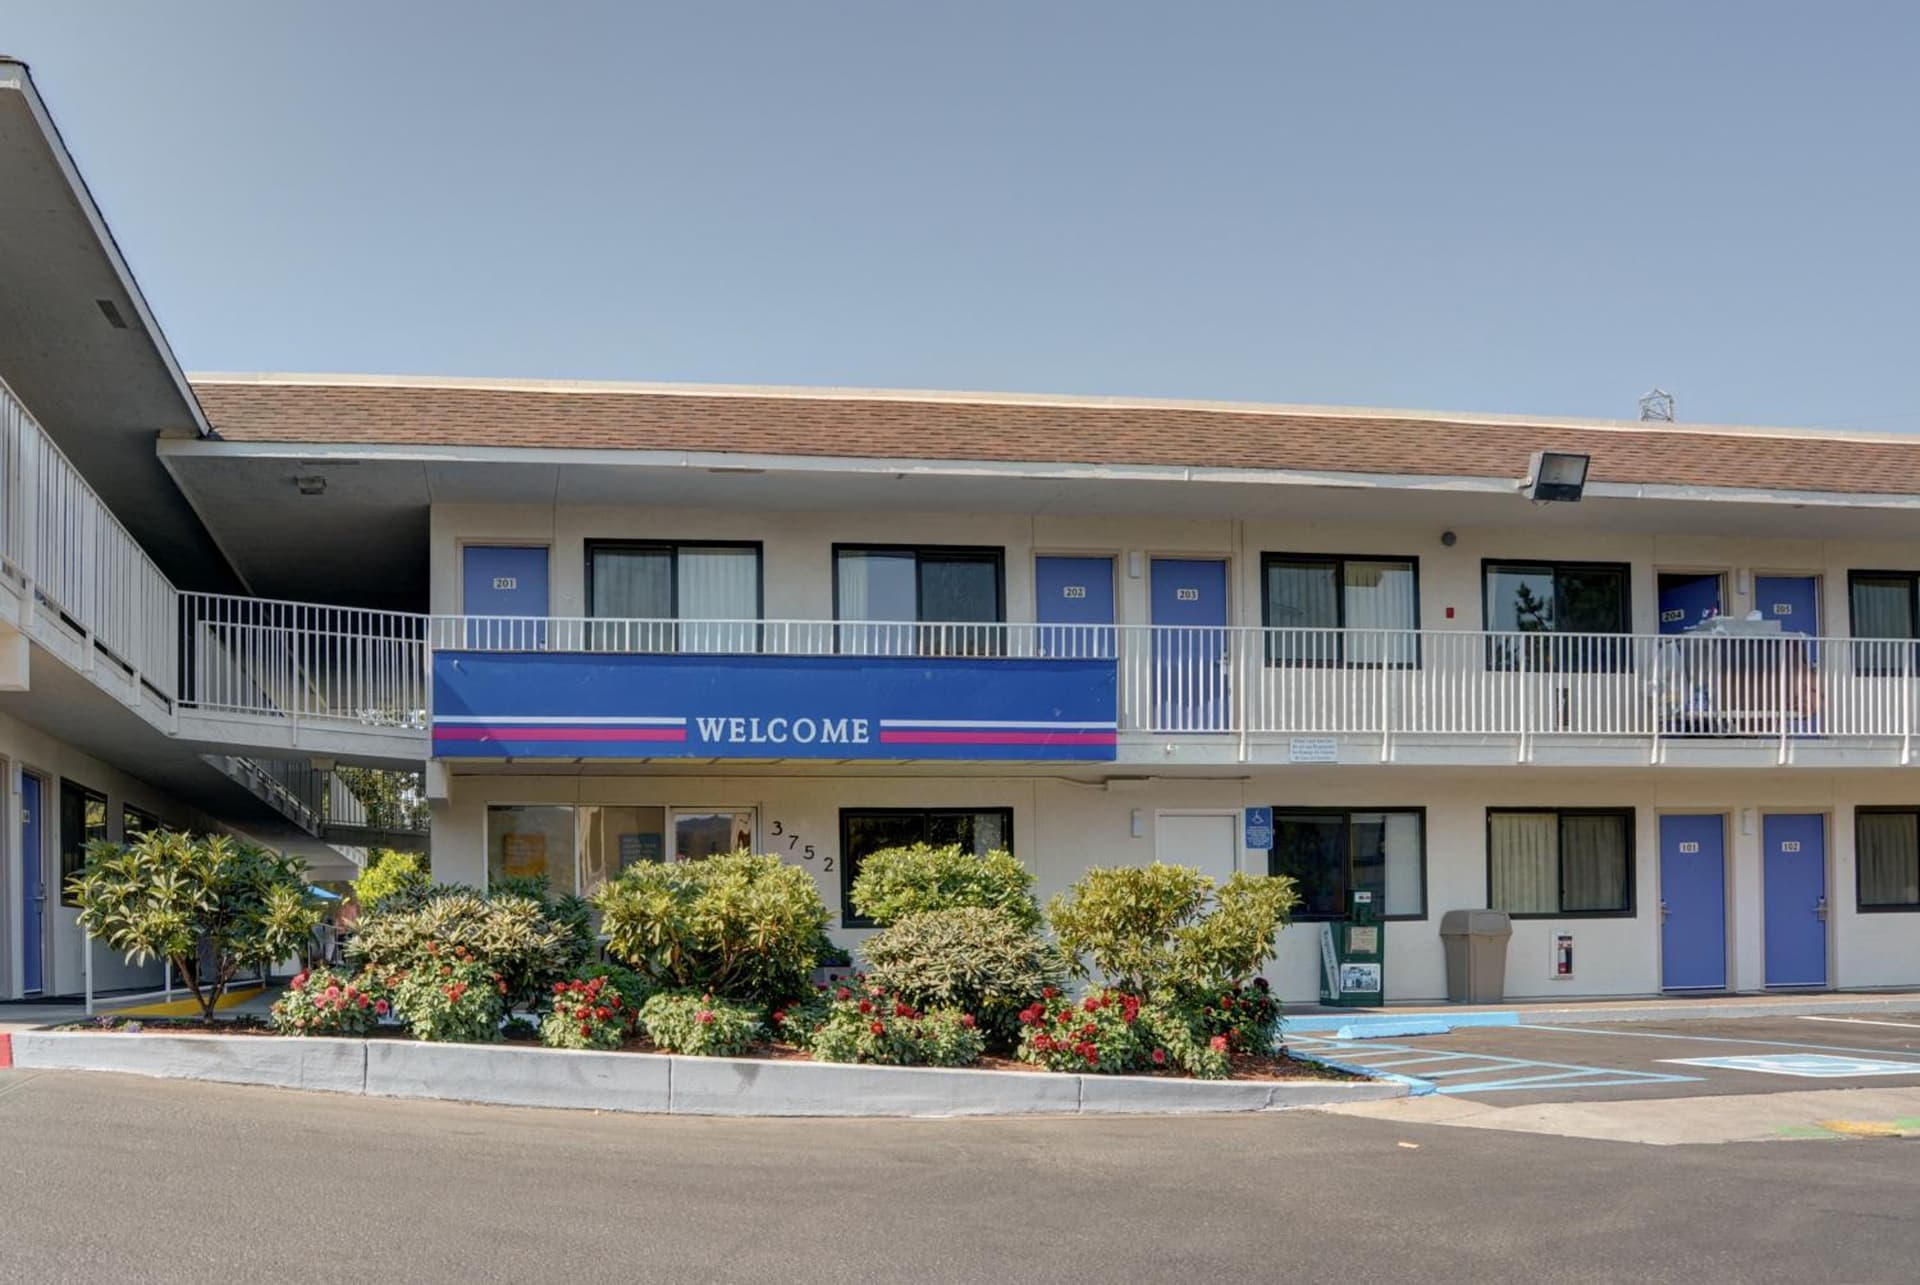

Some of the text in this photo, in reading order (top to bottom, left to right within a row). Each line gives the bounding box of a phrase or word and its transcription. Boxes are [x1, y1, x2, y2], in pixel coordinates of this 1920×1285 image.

[496, 579, 513, 588] 201
[1066, 587, 1083, 597] 202
[1179, 590, 1196, 599] 203
[1663, 611, 1682, 621] 204
[696, 717, 870, 744] WELCOME
[771, 820, 834, 872] 3752
[1682, 843, 1696, 852] 101
[1783, 843, 1798, 851] 102
